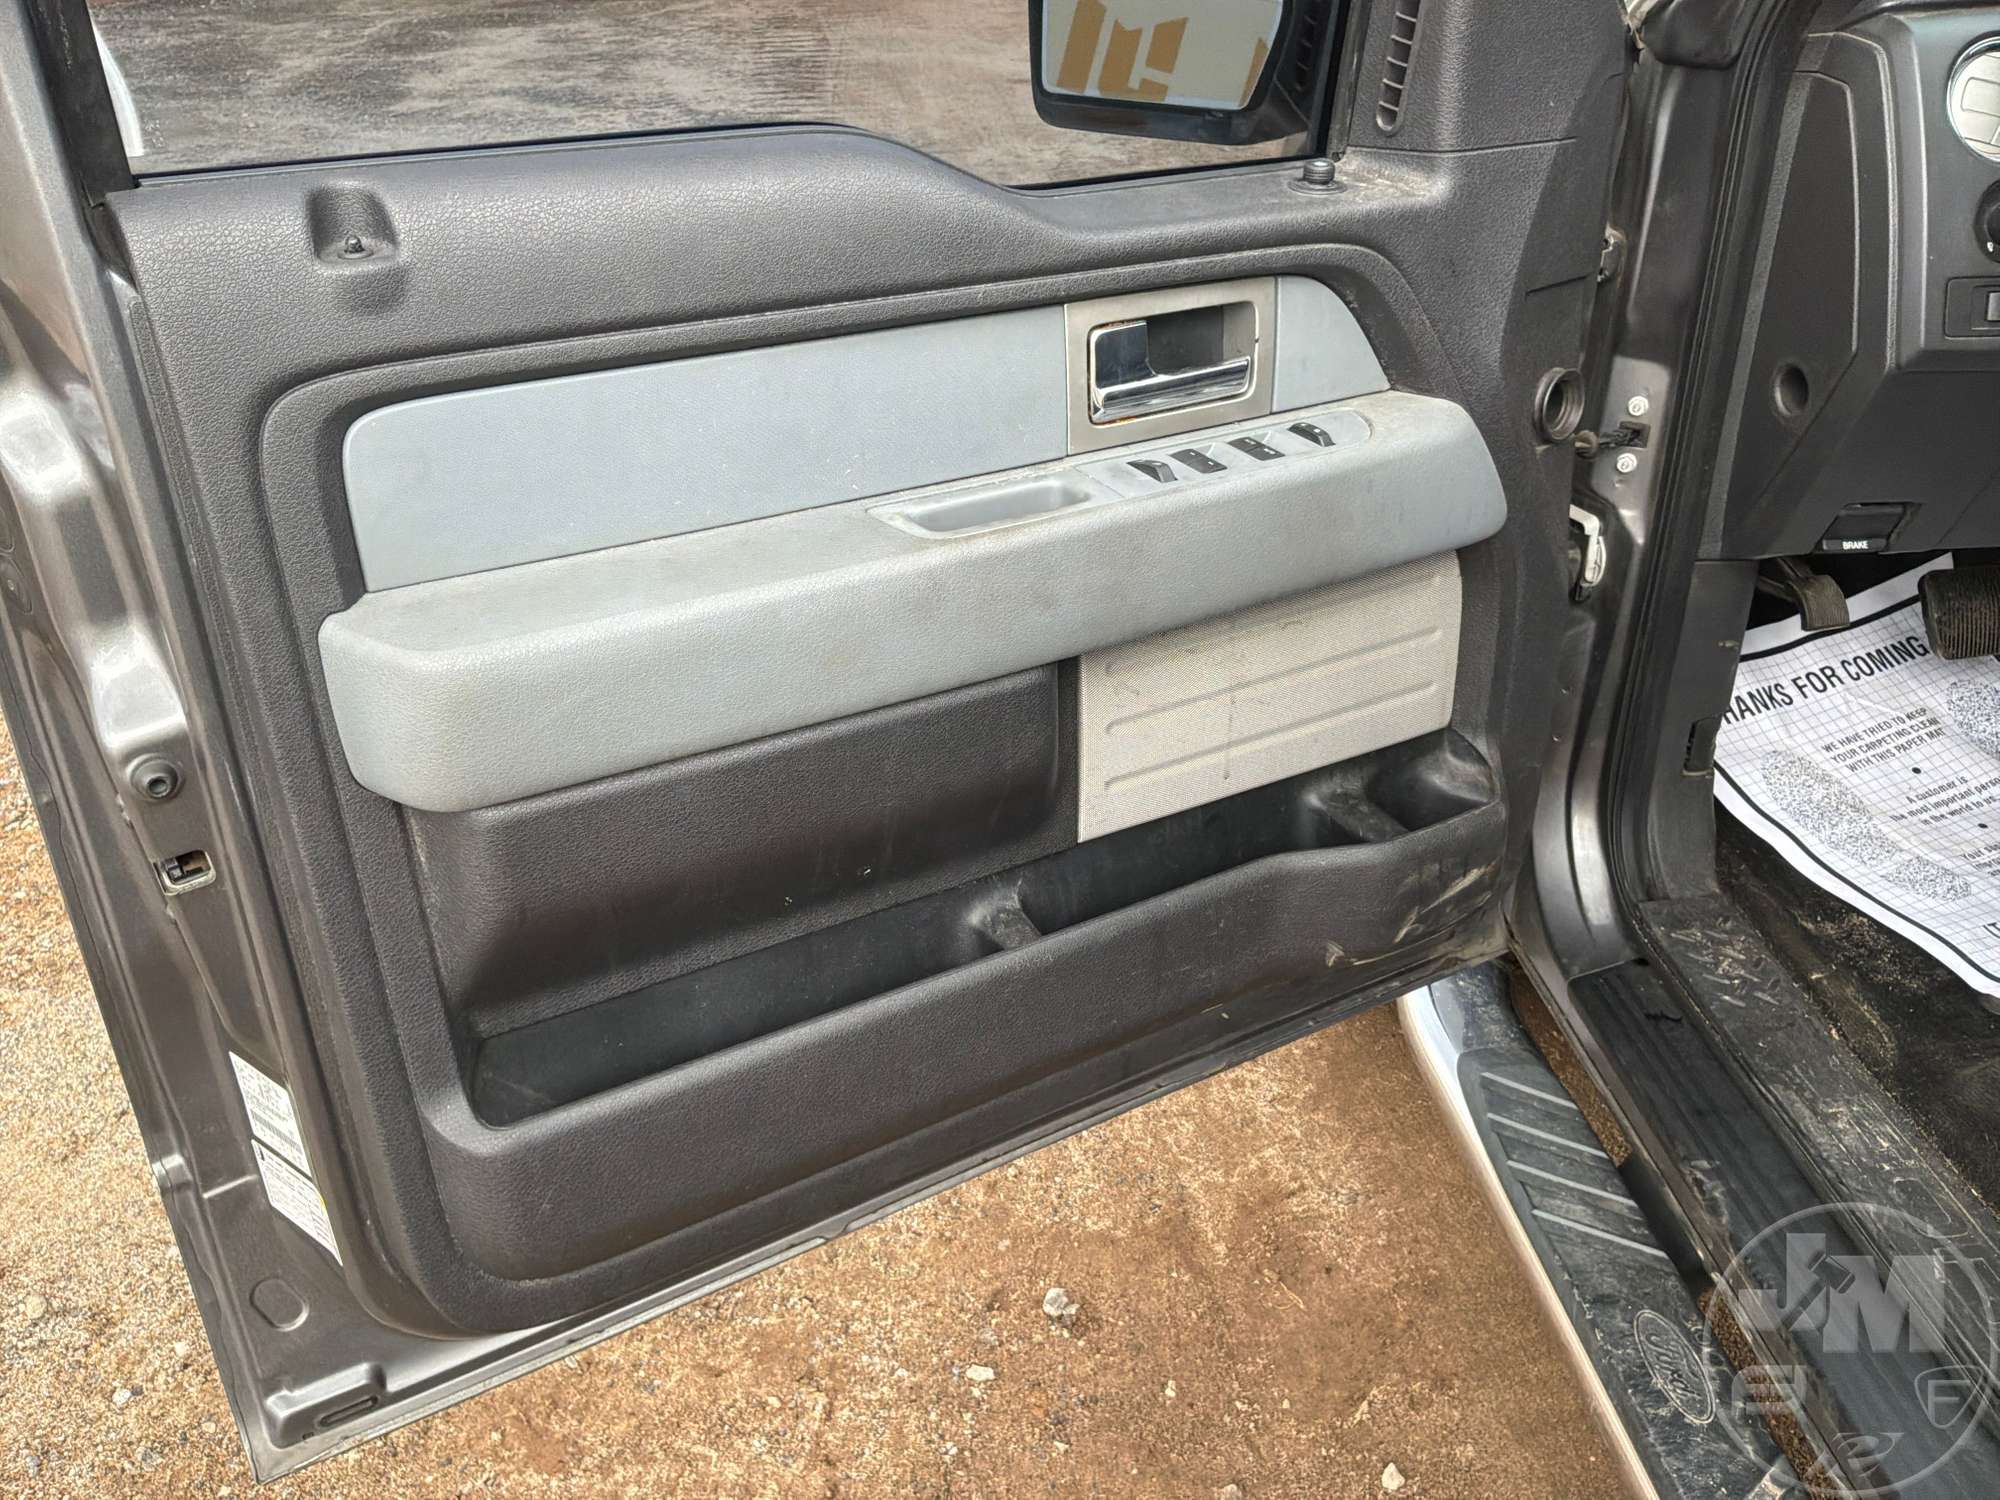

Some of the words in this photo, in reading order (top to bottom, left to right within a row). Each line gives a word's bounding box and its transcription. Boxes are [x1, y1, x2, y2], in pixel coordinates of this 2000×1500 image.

[1842, 540, 1869, 550] BRAKE
[1723, 682, 1794, 725] HANKS
[1791, 665, 1845, 700] FOR
[1840, 636, 1930, 682] COMING
[1822, 742, 1839, 754] WE
[1838, 732, 1865, 749] HAVE
[1863, 720, 1893, 740] TRIED
[1891, 716, 1906, 728] TO
[1904, 707, 1928, 725] KEEP
[1830, 748, 1860, 765] YOUR
[1858, 728, 1912, 756] CARPETING
[1909, 716, 1942, 735] CLEAN
[1844, 757, 1874, 774] WITH
[1873, 748, 1896, 764] THIS
[1894, 735, 1928, 755] PAPER
[1924, 728, 1946, 743] MAT
[1907, 804, 1932, 817] most
[1930, 787, 1976, 809] important
[1915, 780, 1958, 801] customer
[1956, 775, 1969, 785] is
